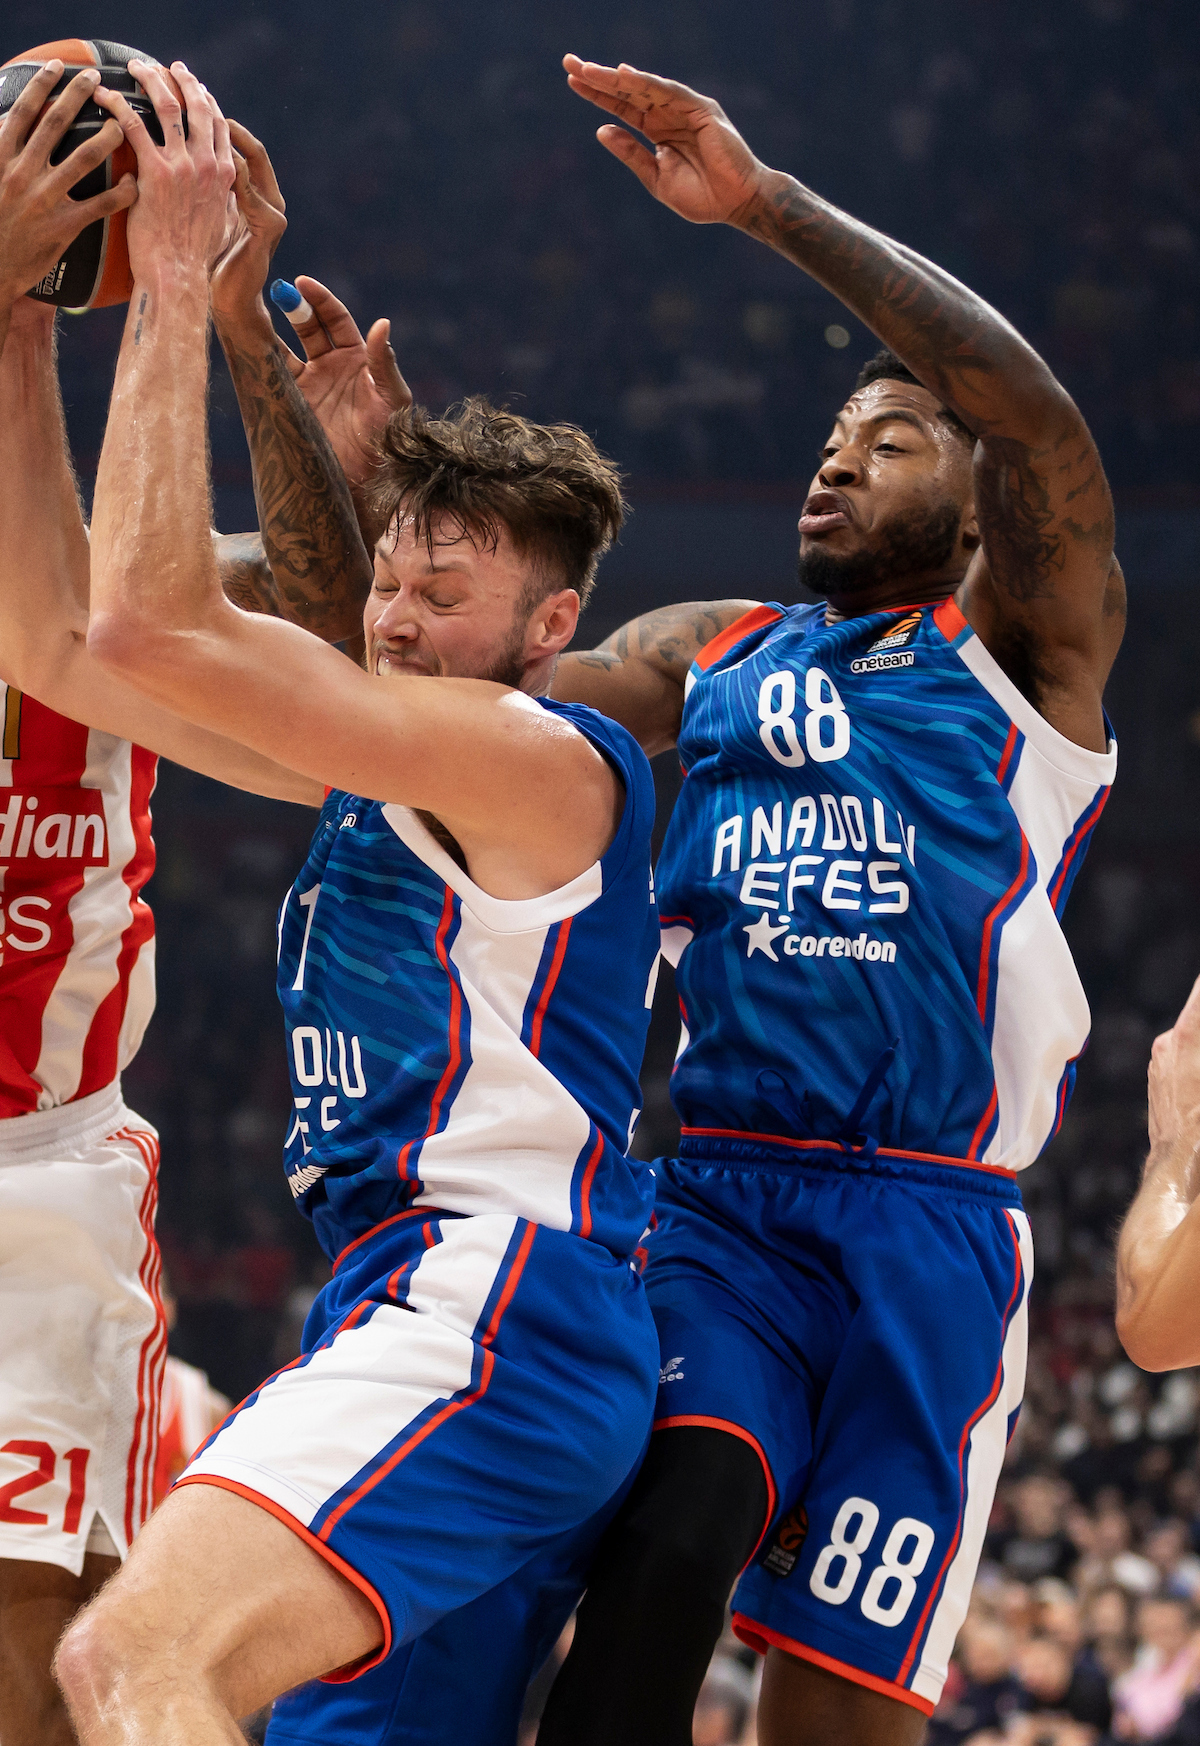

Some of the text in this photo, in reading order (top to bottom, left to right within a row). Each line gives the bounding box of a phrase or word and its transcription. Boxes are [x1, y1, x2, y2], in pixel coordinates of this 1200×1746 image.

[851, 652, 914, 673] oneteam
[758, 667, 850, 768] 88
[739, 855, 909, 914] EFES
[783, 933, 897, 963] corendon
[809, 1497, 934, 1627] 88
